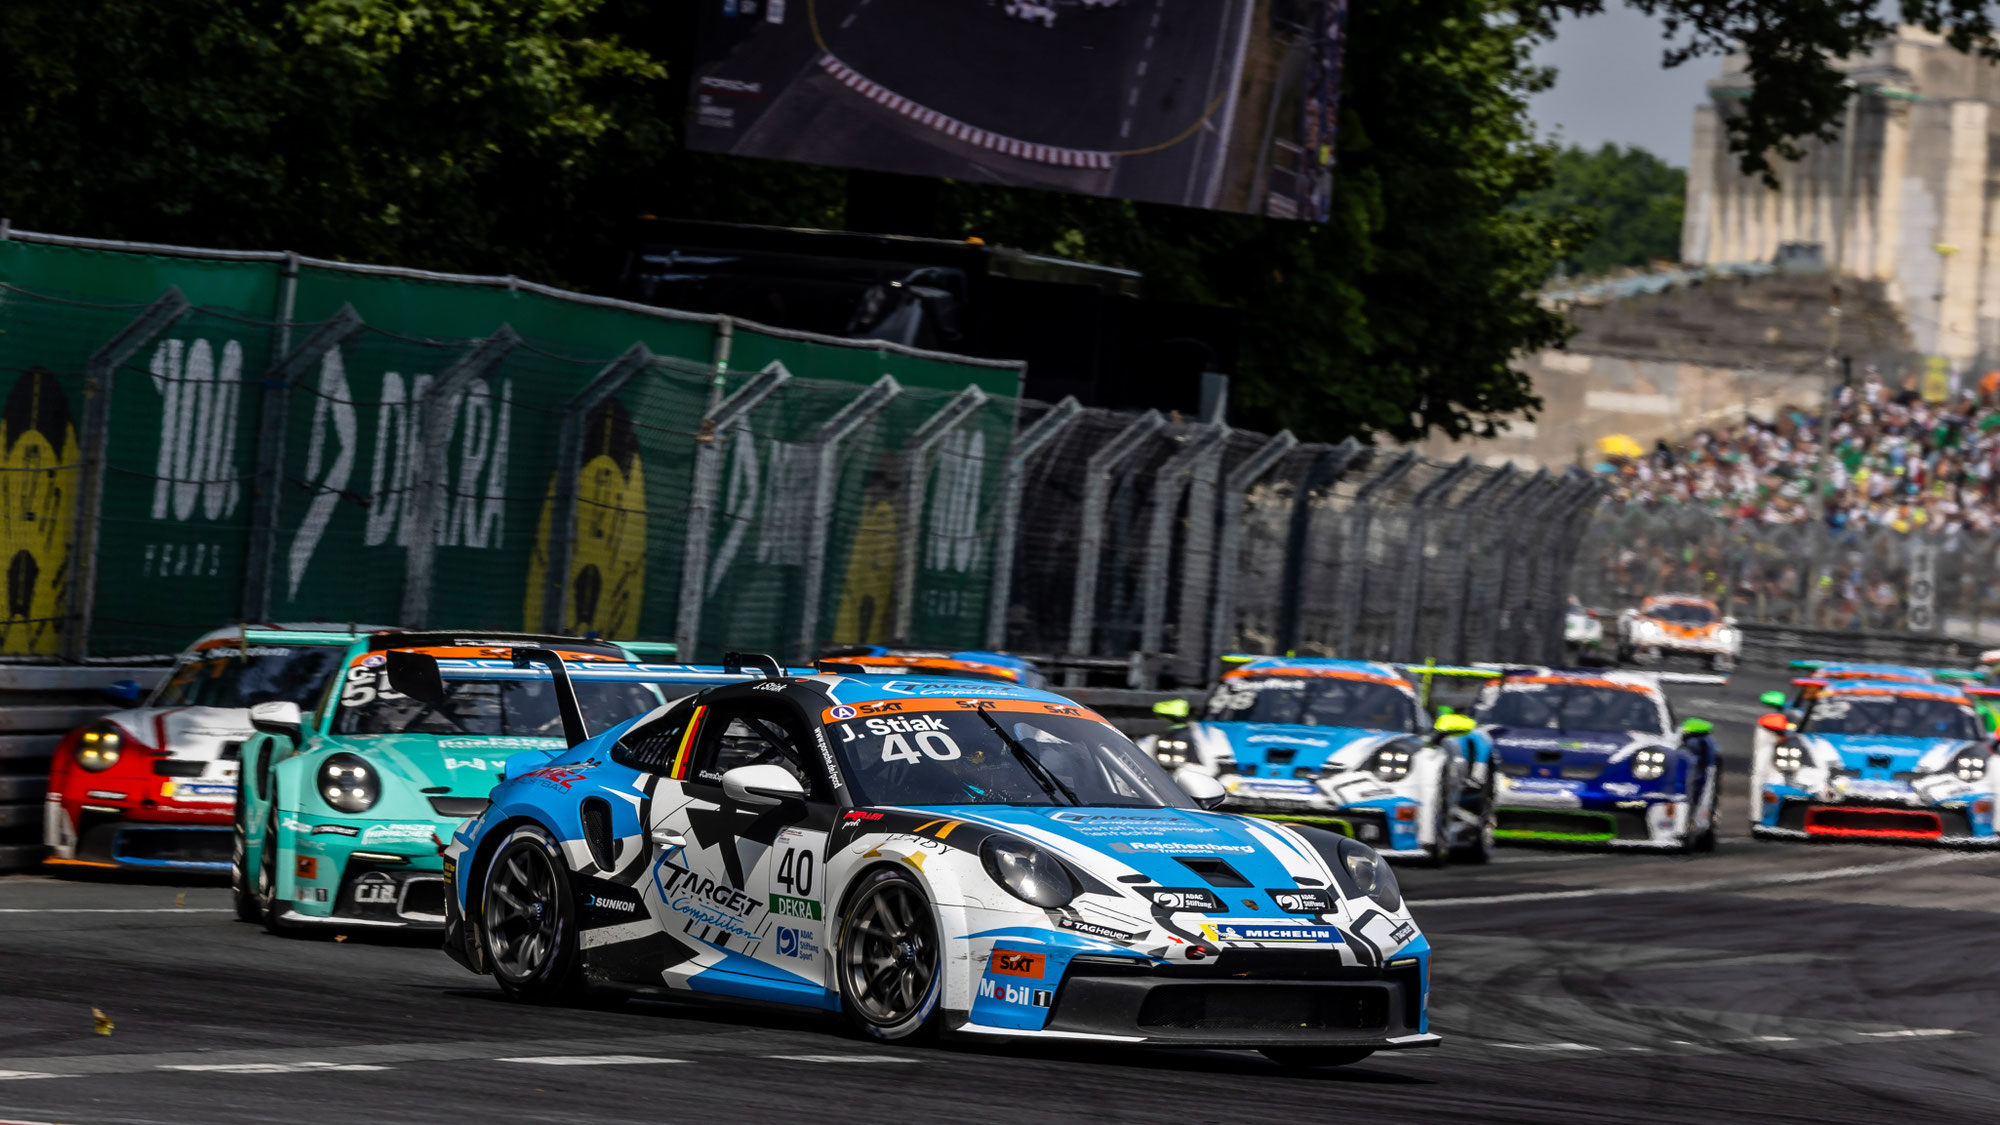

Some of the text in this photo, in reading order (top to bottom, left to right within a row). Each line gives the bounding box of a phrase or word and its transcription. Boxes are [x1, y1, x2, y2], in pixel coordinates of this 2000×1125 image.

[841, 715, 950, 743] J. Stiak
[880, 730, 962, 765] 40
[1128, 841, 1256, 854] Reichenberg
[777, 847, 814, 897] 40
[663, 861, 764, 917] TARGET
[1185, 893, 1204, 901] ADAC
[594, 897, 636, 913] SUNKON
[778, 897, 814, 920] DEKRA
[1185, 900, 1213, 909] Stiftung
[671, 896, 763, 942] Competition
[800, 929, 814, 940] ADAC
[1245, 929, 1331, 939] MICHELIN
[799, 940, 819, 954] Stiftung
[799, 950, 813, 961] Sport
[979, 977, 1030, 1006] Mobil
